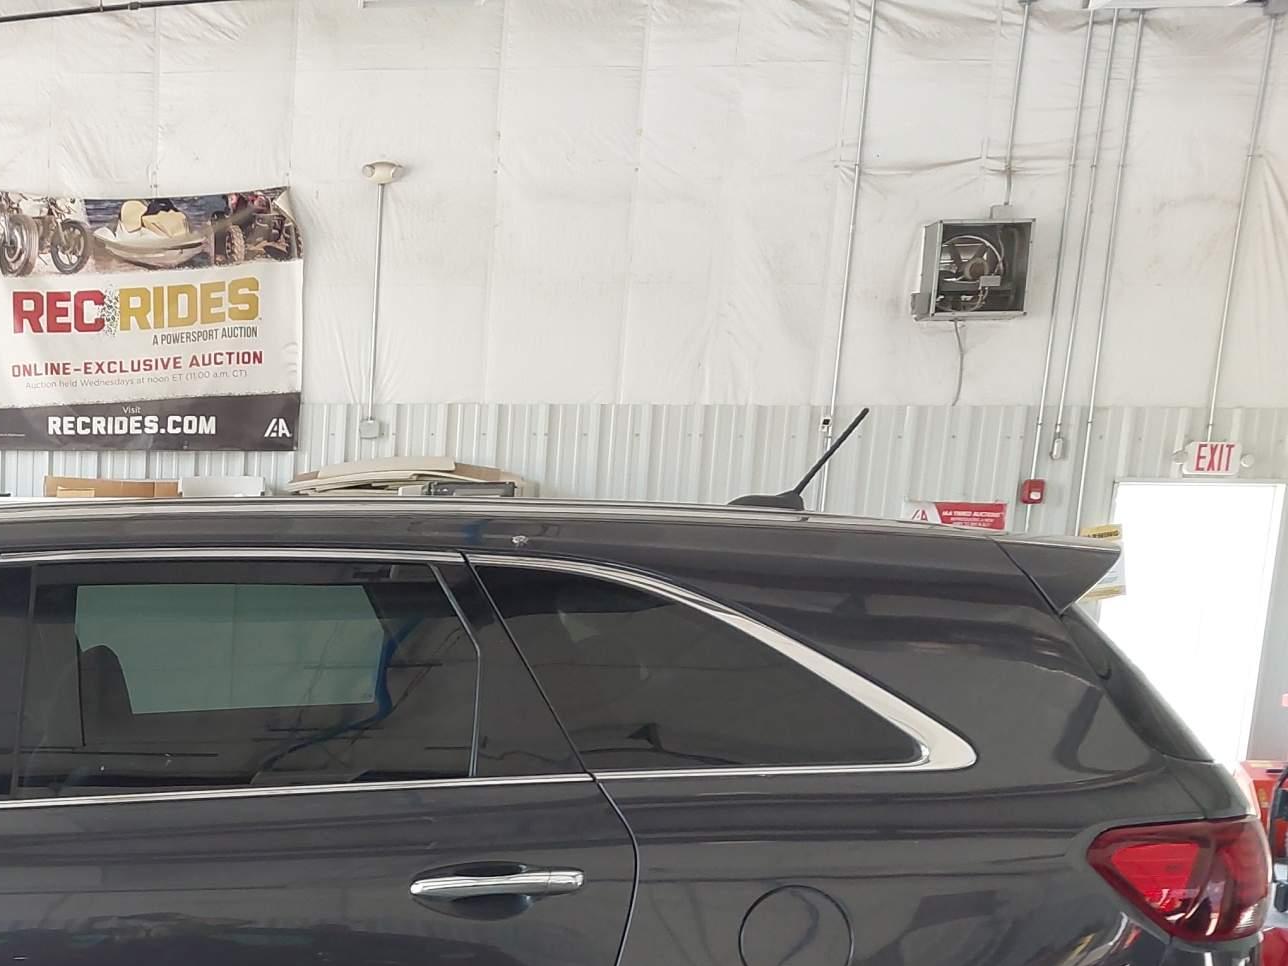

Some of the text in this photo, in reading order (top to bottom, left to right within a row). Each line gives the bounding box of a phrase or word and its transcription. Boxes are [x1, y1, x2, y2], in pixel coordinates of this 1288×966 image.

[12, 277, 260, 334] REC RIDES
[152, 326, 258, 346] A POWERSPORT AUCTION
[11, 350, 263, 378] ONLINE-EXCLUSIVE AUCTION
[25, 380, 57, 389] Auction
[59, 379, 78, 388] held
[80, 377, 134, 387] Wednesdays
[122, 406, 141, 414] Visit
[47, 415, 217, 436] RECRIDES.COM
[1194, 443, 1236, 472] EXIT
